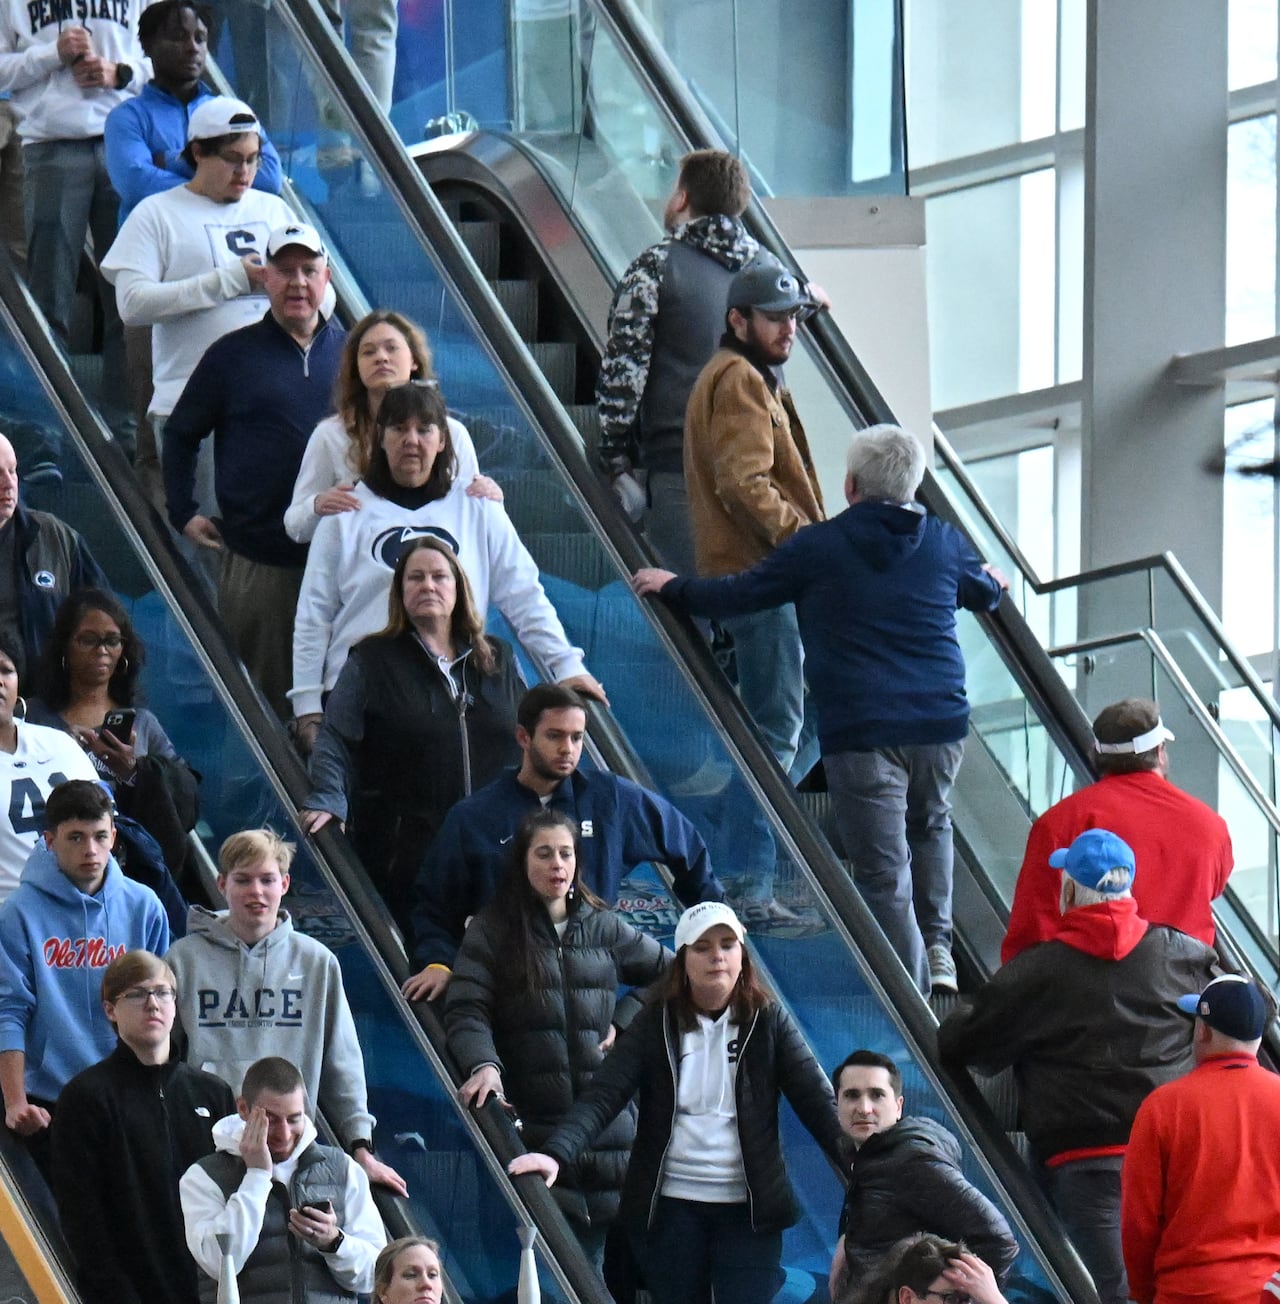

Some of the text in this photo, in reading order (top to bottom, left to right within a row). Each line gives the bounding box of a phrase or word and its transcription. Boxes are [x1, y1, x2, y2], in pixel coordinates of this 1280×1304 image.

[27, 0, 129, 35] PENN STATE
[44, 936, 76, 969] Ole
[198, 988, 302, 1019] PACE
